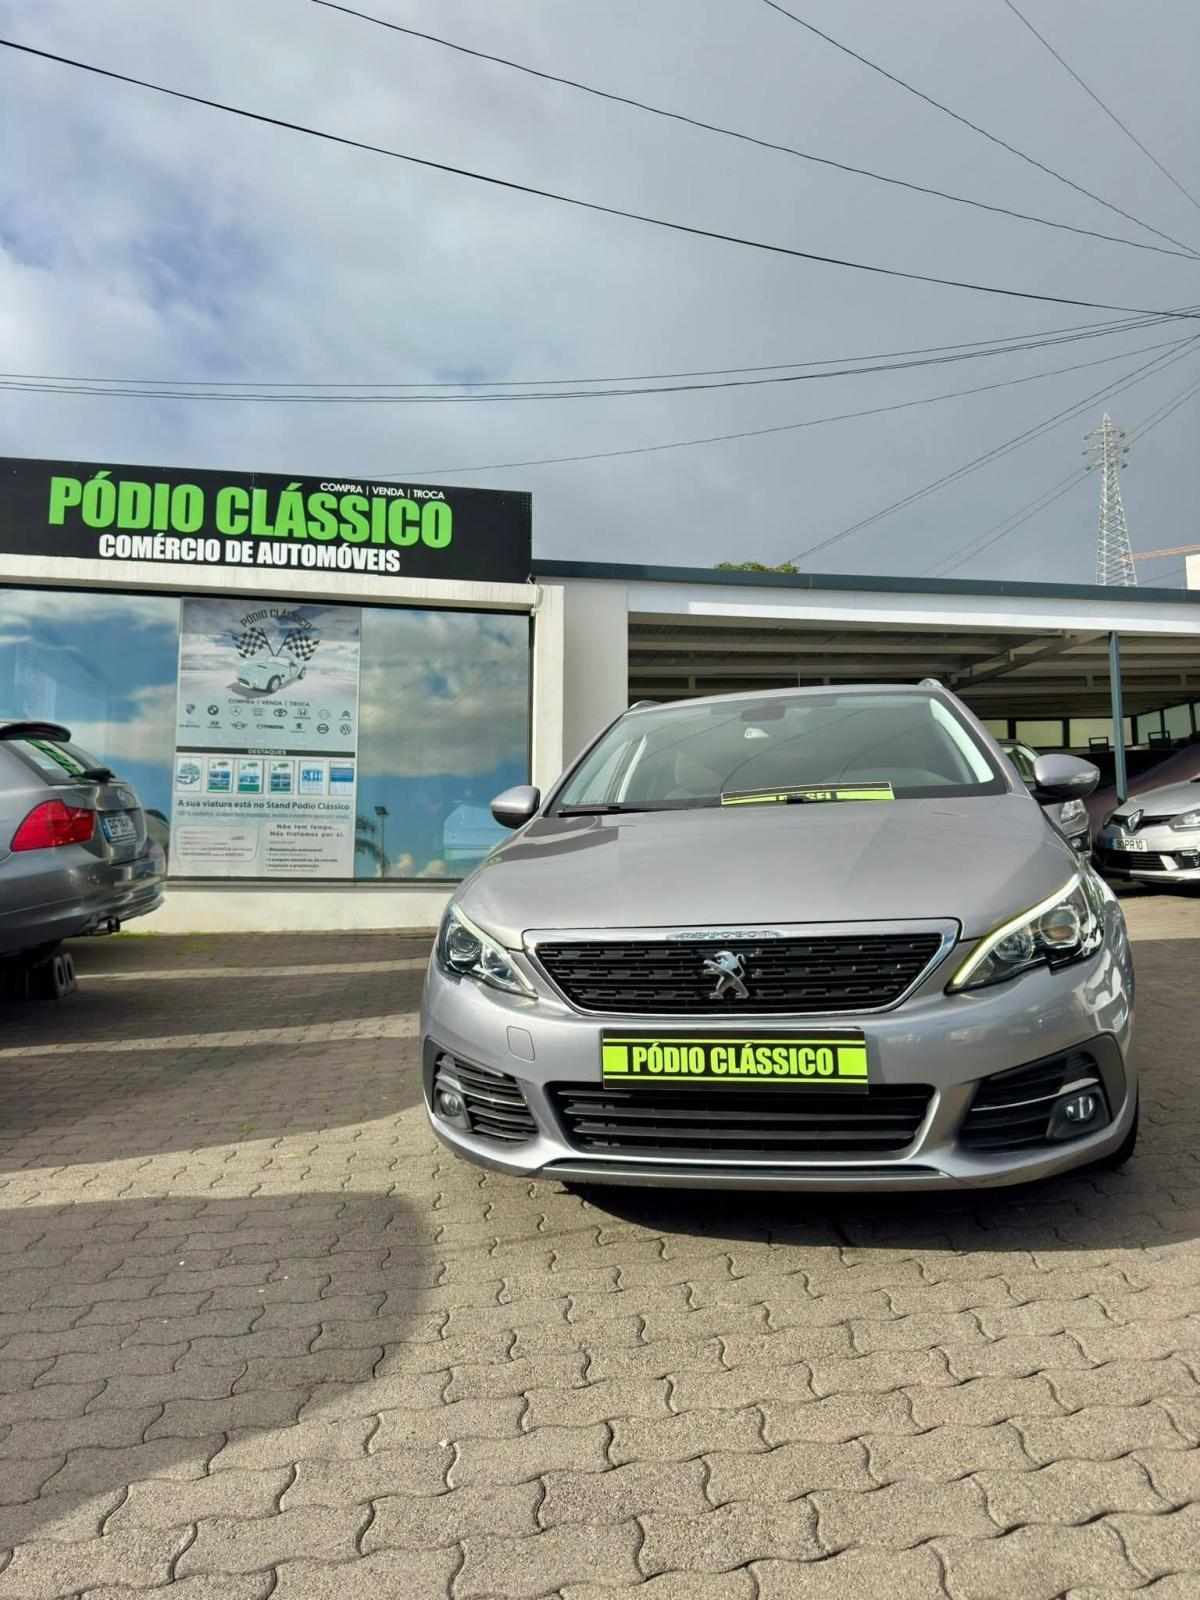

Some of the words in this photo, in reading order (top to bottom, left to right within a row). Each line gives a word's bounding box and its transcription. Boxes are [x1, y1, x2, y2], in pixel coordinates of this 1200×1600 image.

[320, 482, 363, 494] COMPRA
[372, 485, 405, 497] VENDA
[413, 489, 446, 500] TROCA
[49, 470, 204, 531] PÓDIO
[215, 482, 453, 549] CLÁSSICO
[99, 533, 221, 563] COMÉRCIO
[225, 540, 254, 565] DE
[257, 538, 402, 573] AUTOMÓVEIS
[202, 800, 233, 809] viatura
[233, 800, 252, 809] está
[266, 800, 291, 810] Stand
[632, 1042, 705, 1073] PÓDIO
[710, 1043, 834, 1076] CLÁSSICO
